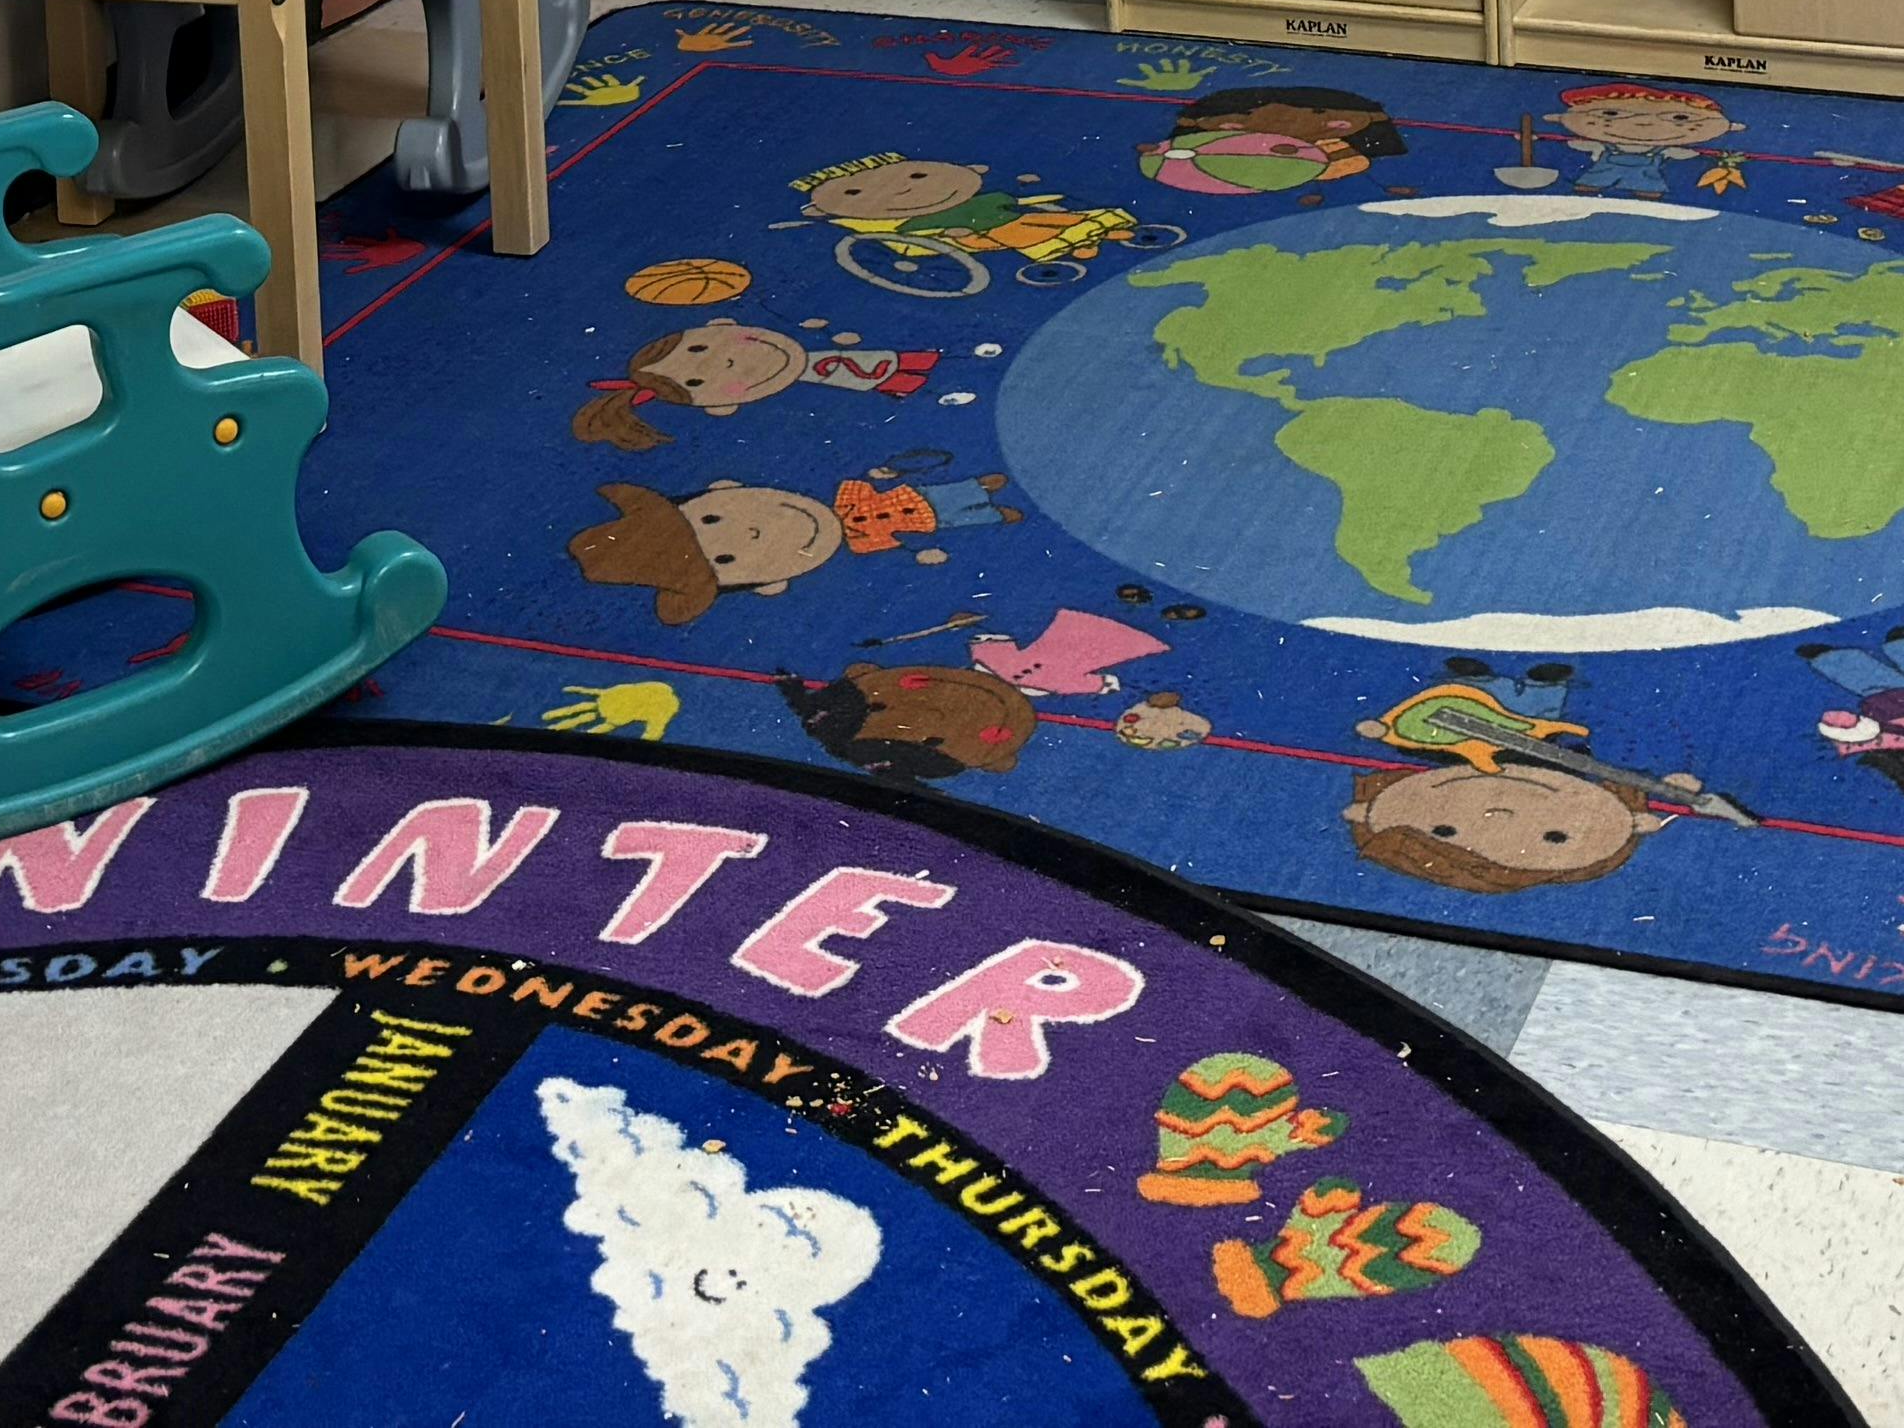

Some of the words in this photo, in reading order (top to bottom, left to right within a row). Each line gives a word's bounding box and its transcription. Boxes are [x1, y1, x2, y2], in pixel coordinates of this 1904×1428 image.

[1286, 18, 1348, 35] KAPLAN
[1703, 53, 1768, 72] KAPLAN
[339, 949, 806, 1090] WEDNESDAY
[250, 1004, 471, 1207] JANUARY
[48, 1231, 285, 1428] BRUARY
[870, 1115, 1208, 1385] THURSDAY
